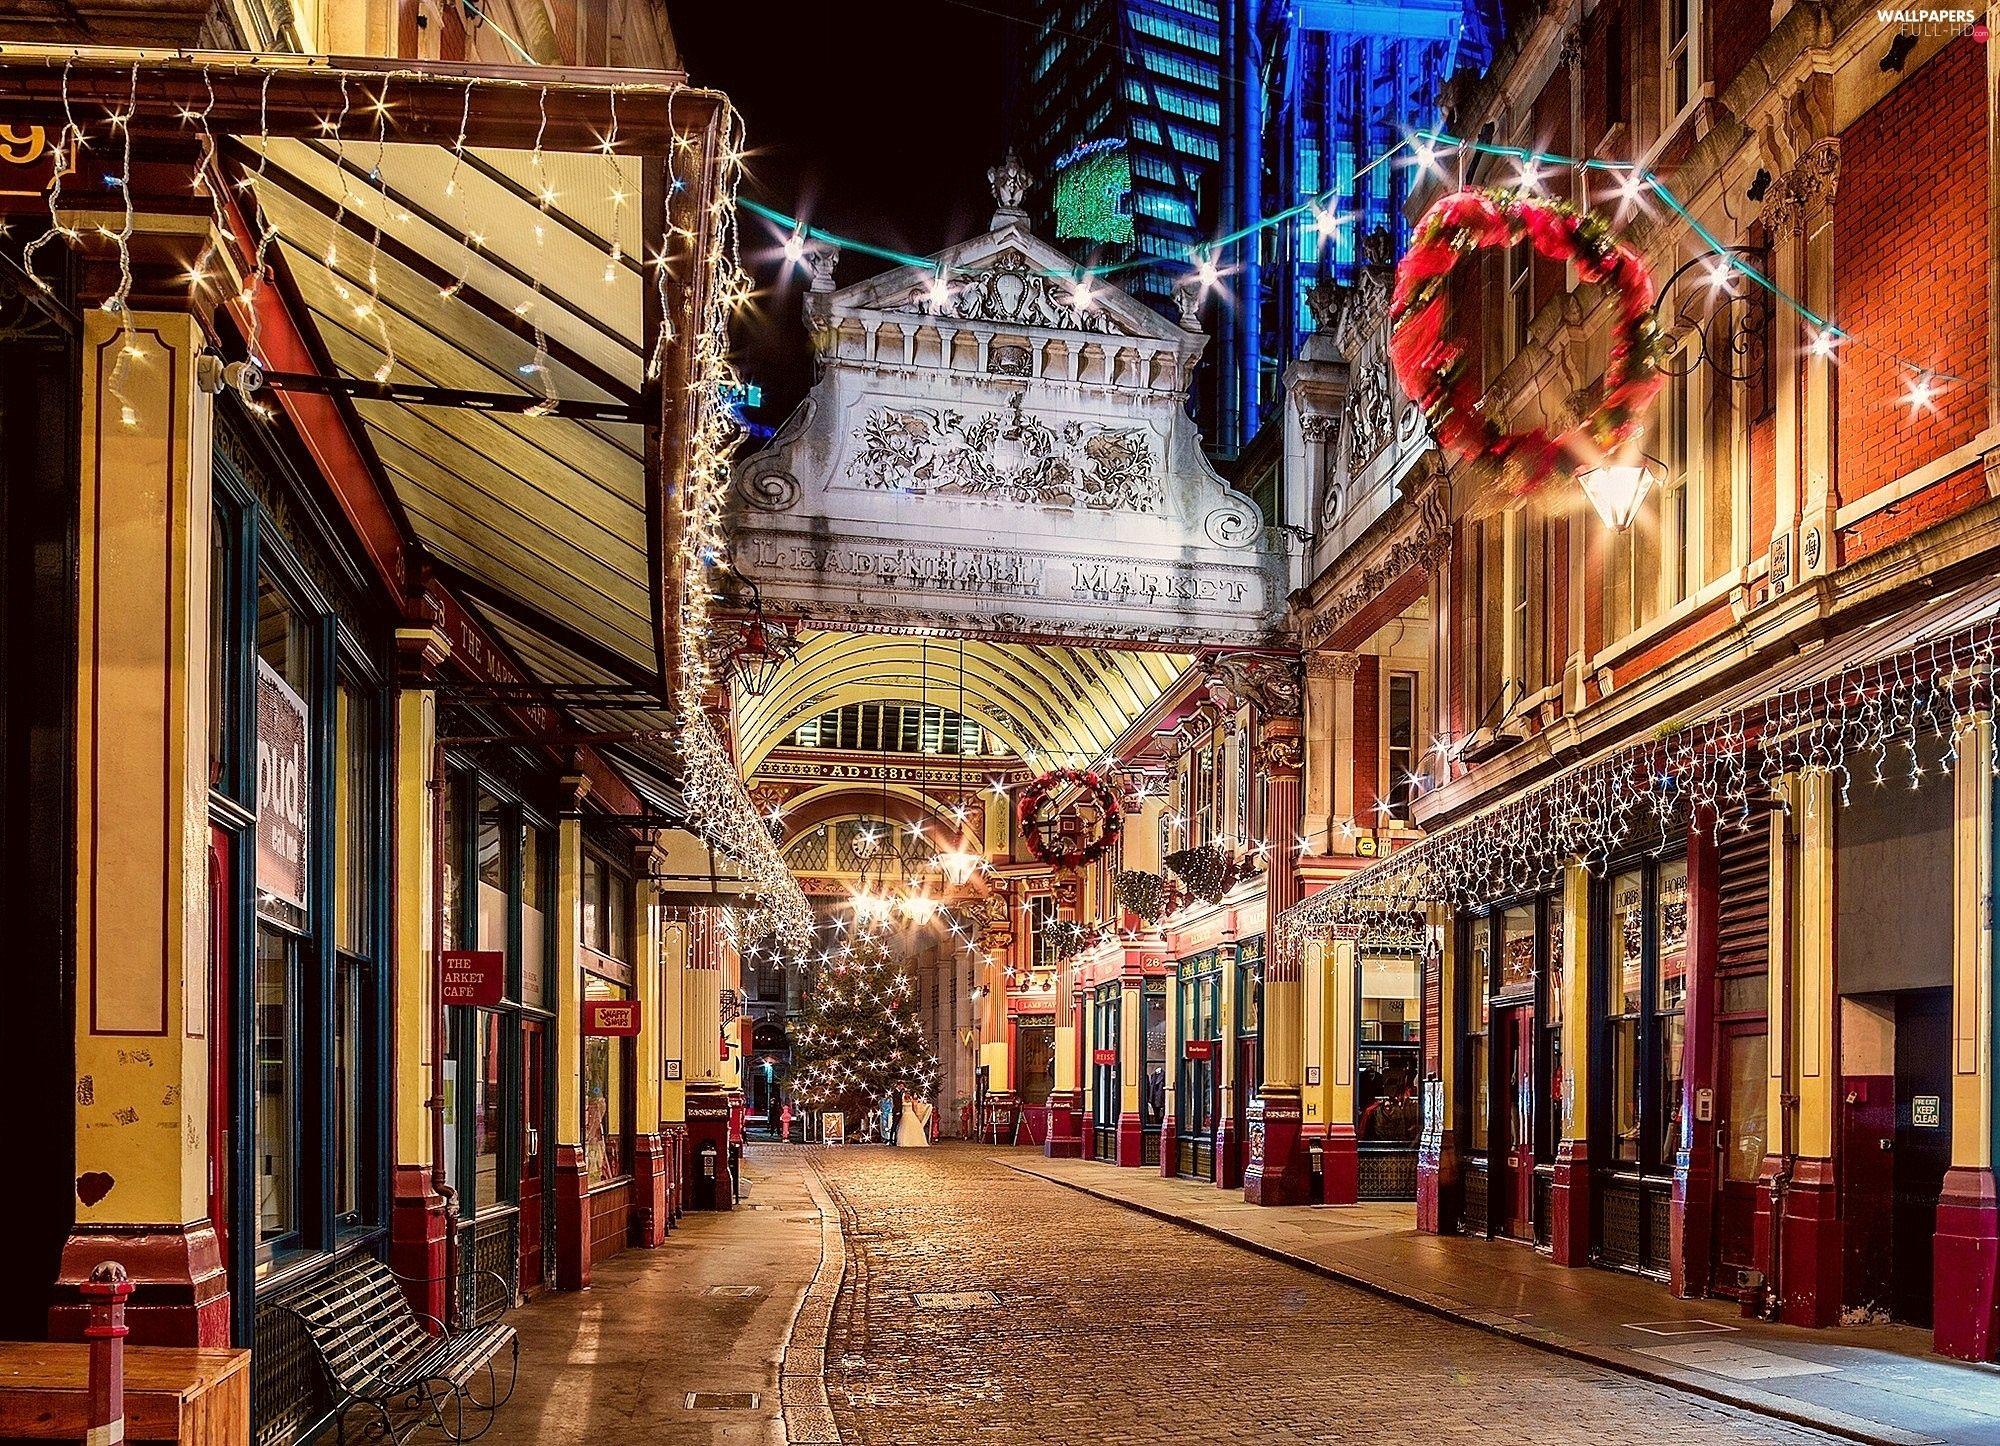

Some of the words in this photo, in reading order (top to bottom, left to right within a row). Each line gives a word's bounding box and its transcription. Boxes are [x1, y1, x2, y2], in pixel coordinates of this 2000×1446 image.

[753, 538, 1040, 590] LEADENHALL
[1071, 562, 1249, 603] MARKET
[460, 620, 482, 665] THE
[870, 767, 907, 781] 1881
[1664, 875, 1687, 893] HOBB
[446, 958, 472, 969] THE
[443, 972, 485, 983] ARKET
[443, 984, 474, 997] CAFÉ
[1307, 1103, 1317, 1116] H
[1917, 1106, 1935, 1115] KEEP
[1914, 1115, 1937, 1124] CLEAR
